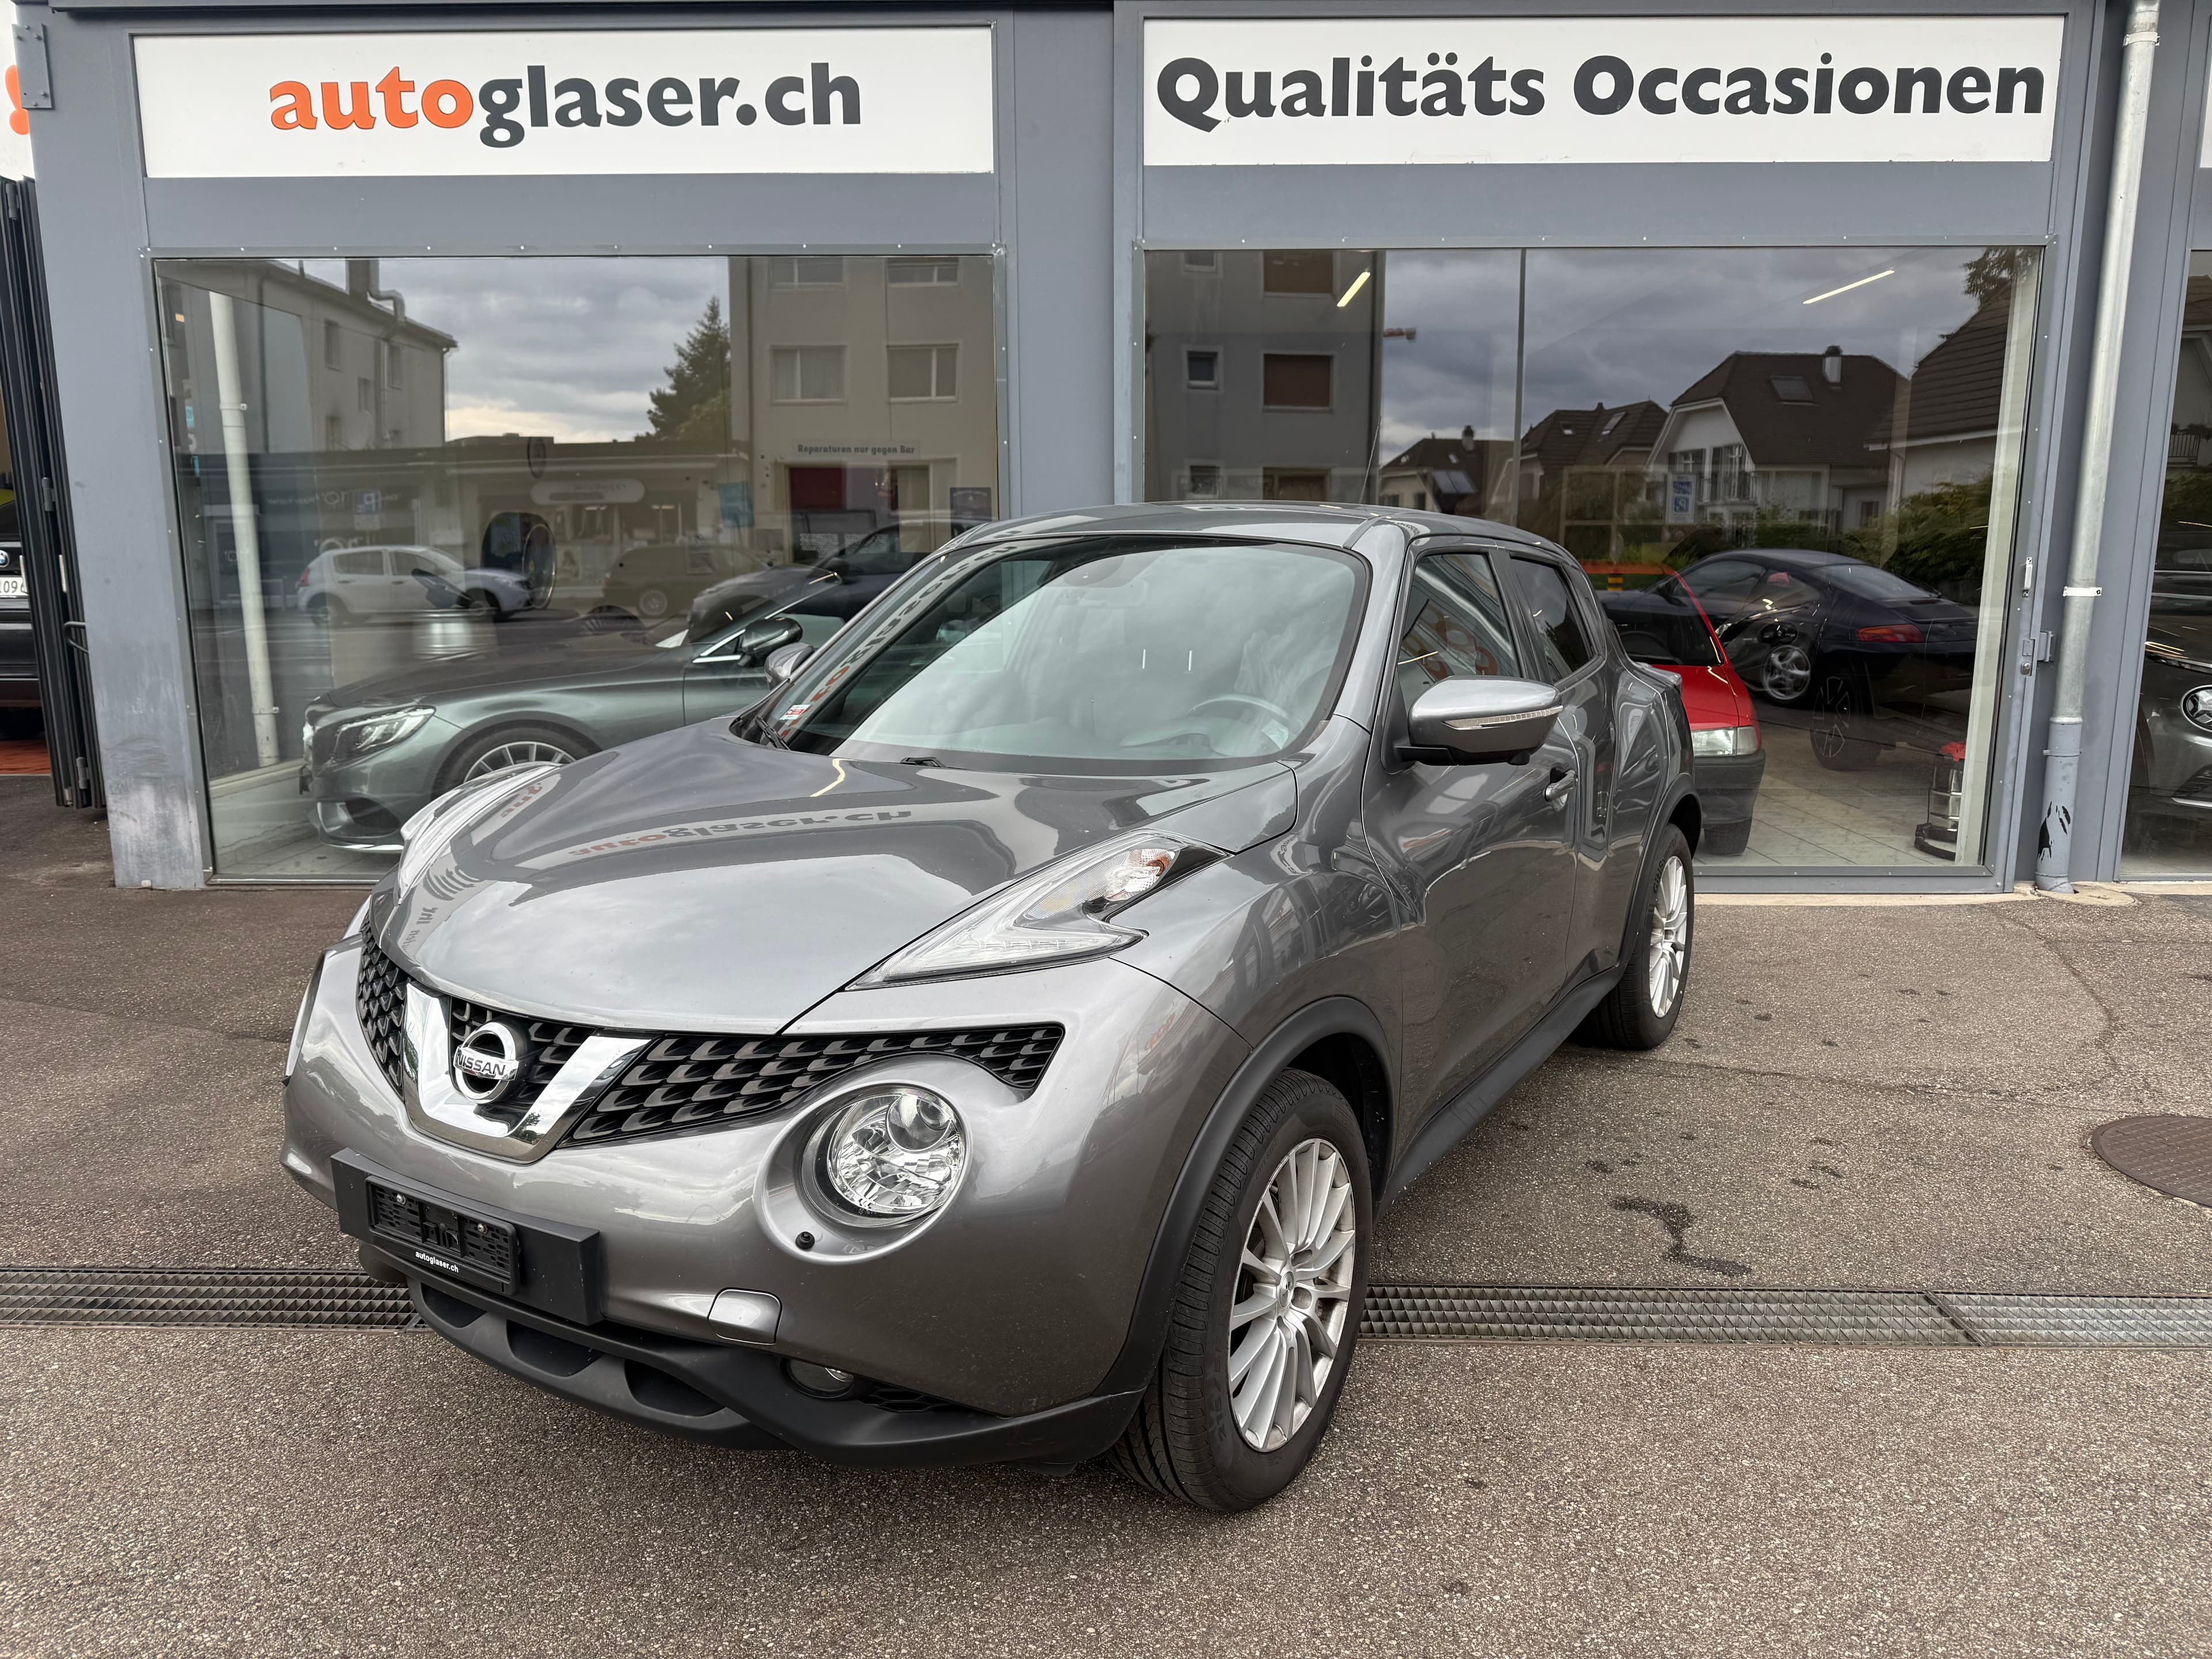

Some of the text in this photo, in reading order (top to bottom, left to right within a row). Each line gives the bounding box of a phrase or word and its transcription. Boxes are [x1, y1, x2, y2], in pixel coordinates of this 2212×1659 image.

[270, 62, 861, 148] autoglaser.ch
[1157, 52, 2045, 132] Qualitäts Occasionen
[797, 444, 851, 454] Reparaturen
[871, 447, 897, 455] gegen
[900, 445, 915, 454] Bar
[456, 1048, 506, 1076] NISSAN
[415, 1251, 459, 1273] autoglaser.ch
